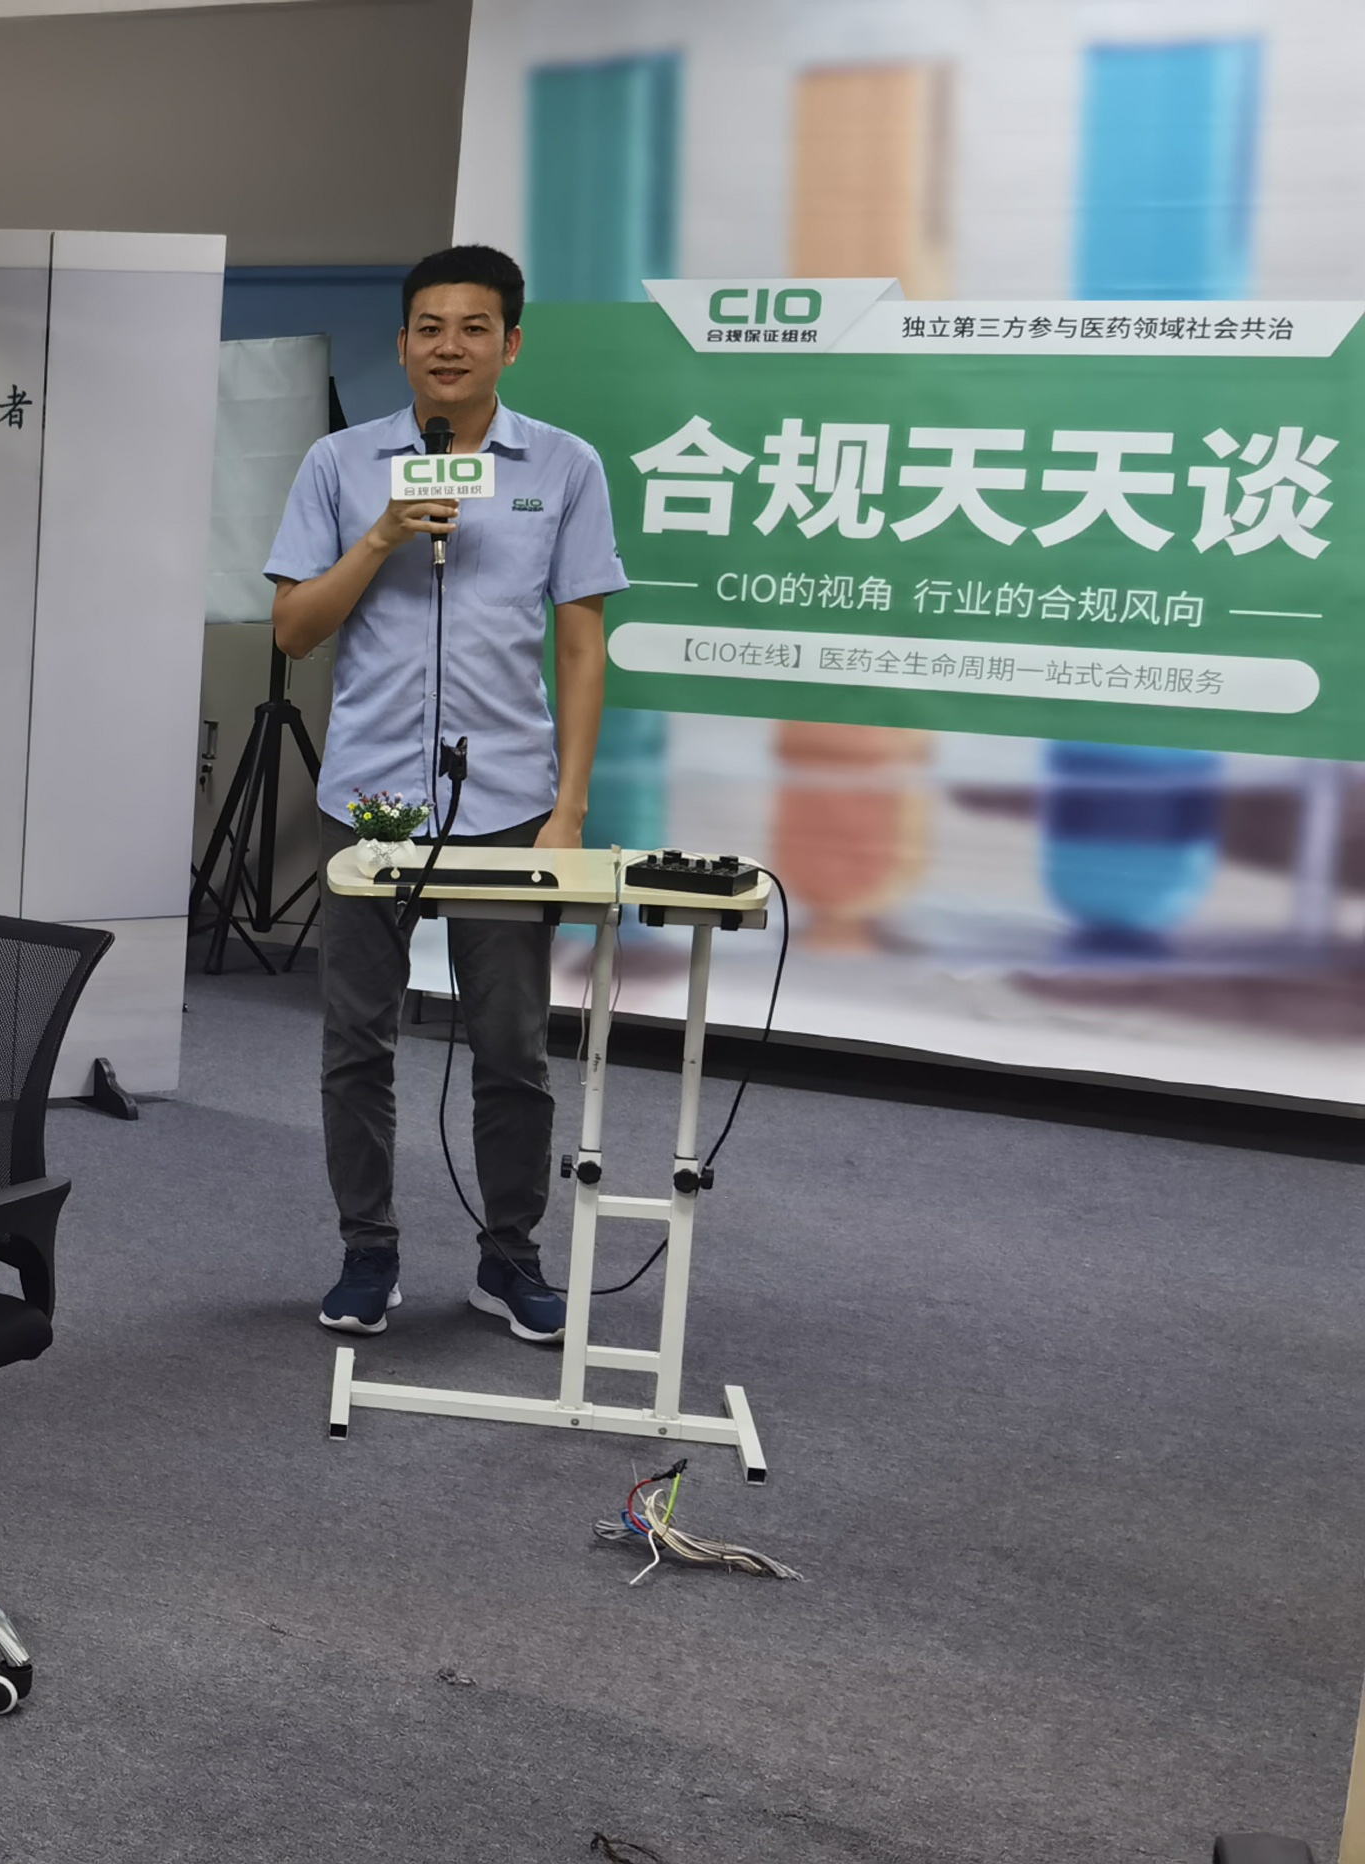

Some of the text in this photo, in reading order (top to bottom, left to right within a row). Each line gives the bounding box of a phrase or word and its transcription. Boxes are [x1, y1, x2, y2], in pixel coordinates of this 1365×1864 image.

[709, 288, 822, 325] CIO
[706, 329, 818, 344] 合规保证组织
[902, 315, 1295, 342] 独立第三方参与医药领域社会共治
[403, 458, 483, 484] CIO
[512, 499, 543, 508] CIO
[630, 415, 1340, 560] 合规天天谈
[716, 572, 1204, 628] CIO的视角 行业的合规风向
[818, 647, 1225, 696] 医药全生命周期一站式合规服务
